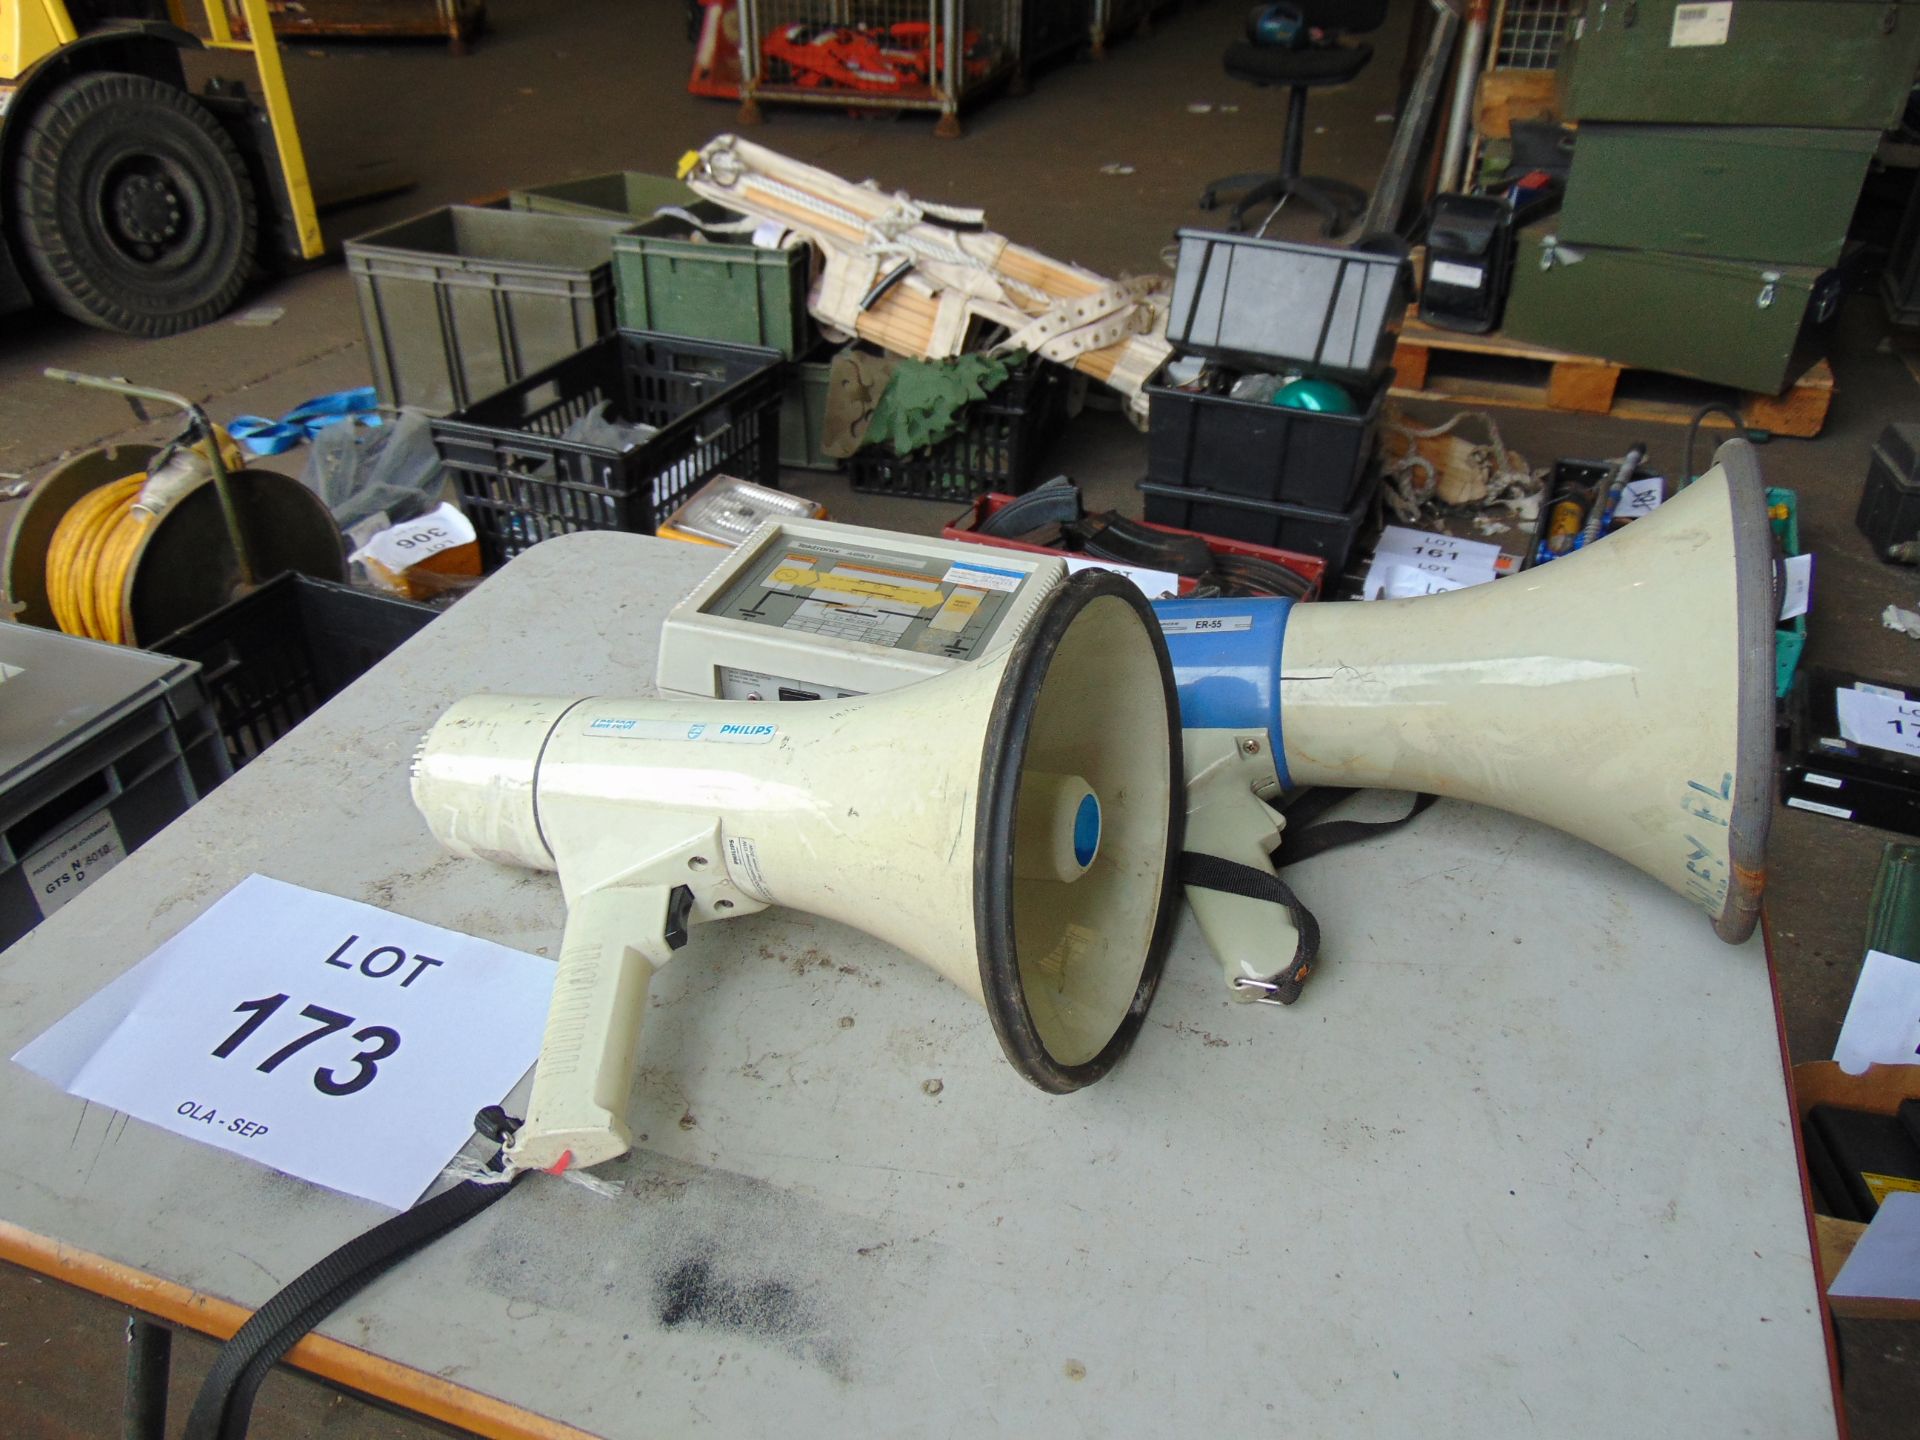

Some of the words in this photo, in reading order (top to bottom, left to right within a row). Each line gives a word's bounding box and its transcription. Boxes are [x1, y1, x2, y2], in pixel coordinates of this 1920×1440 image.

[396, 528, 447, 549] 306
[1425, 537, 1457, 548] LOT
[426, 540, 455, 553] LOT
[1412, 546, 1460, 561] 161
[1417, 563, 1449, 573] LOT
[1195, 620, 1222, 629] ER-55
[720, 724, 774, 735] PHILIPS
[45, 873, 71, 895] GTS
[325, 935, 444, 987] LOT
[211, 993, 401, 1096] 173
[177, 1101, 215, 1125] OLA
[227, 1117, 269, 1139] SEP
